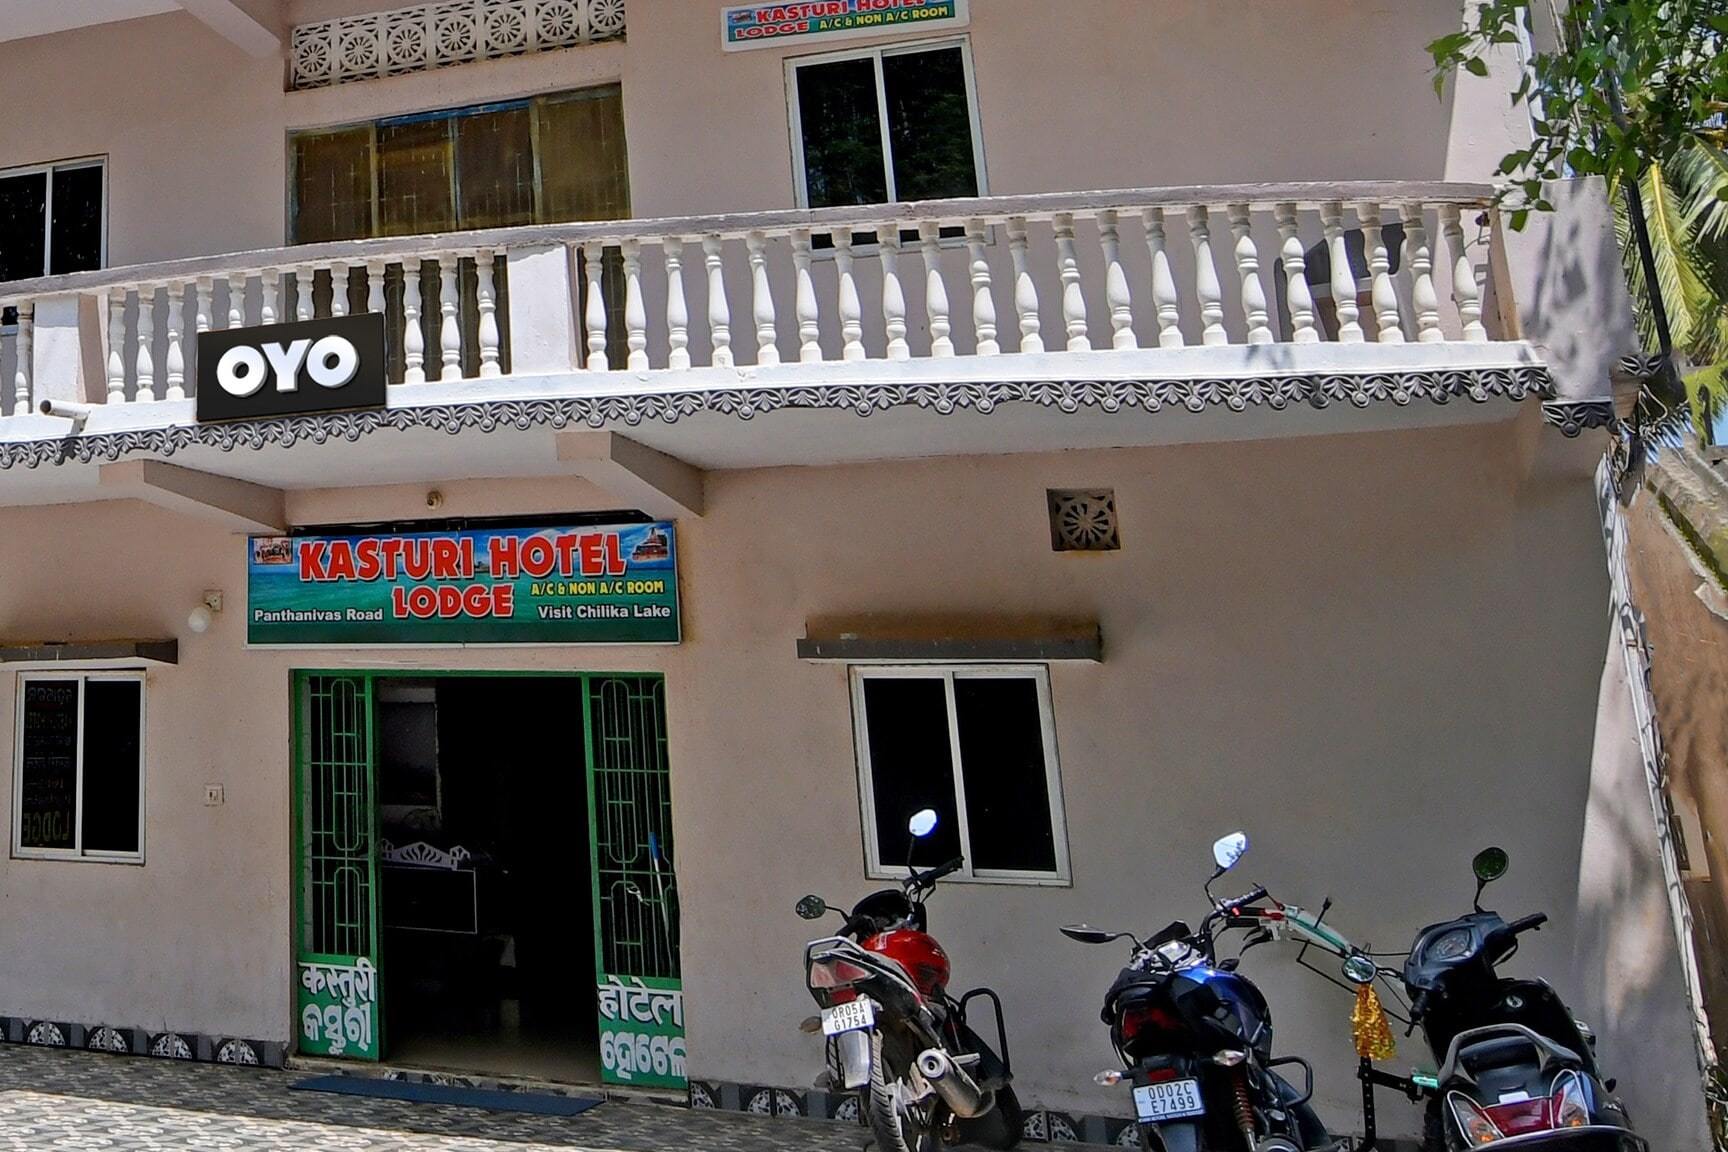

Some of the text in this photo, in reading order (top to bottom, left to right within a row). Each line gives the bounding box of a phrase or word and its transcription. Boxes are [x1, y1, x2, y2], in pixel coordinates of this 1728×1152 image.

[735, 6, 948, 39] LODGE A/C & NON A/C ROOM
[755, 0, 849, 24] KASTURI
[216, 335, 359, 397] OYO
[298, 532, 627, 581] KASTURI HOTEL
[392, 583, 515, 618] LODGE
[531, 580, 664, 596] A/C & NON A/C ROOM
[254, 608, 383, 621] Panthanivas Road
[538, 604, 671, 619] Visit Chilika Lake
[298, 957, 377, 1008] कस्तुरी
[597, 974, 683, 1027] होटेल
[1151, 1096, 1195, 1114] E7499
